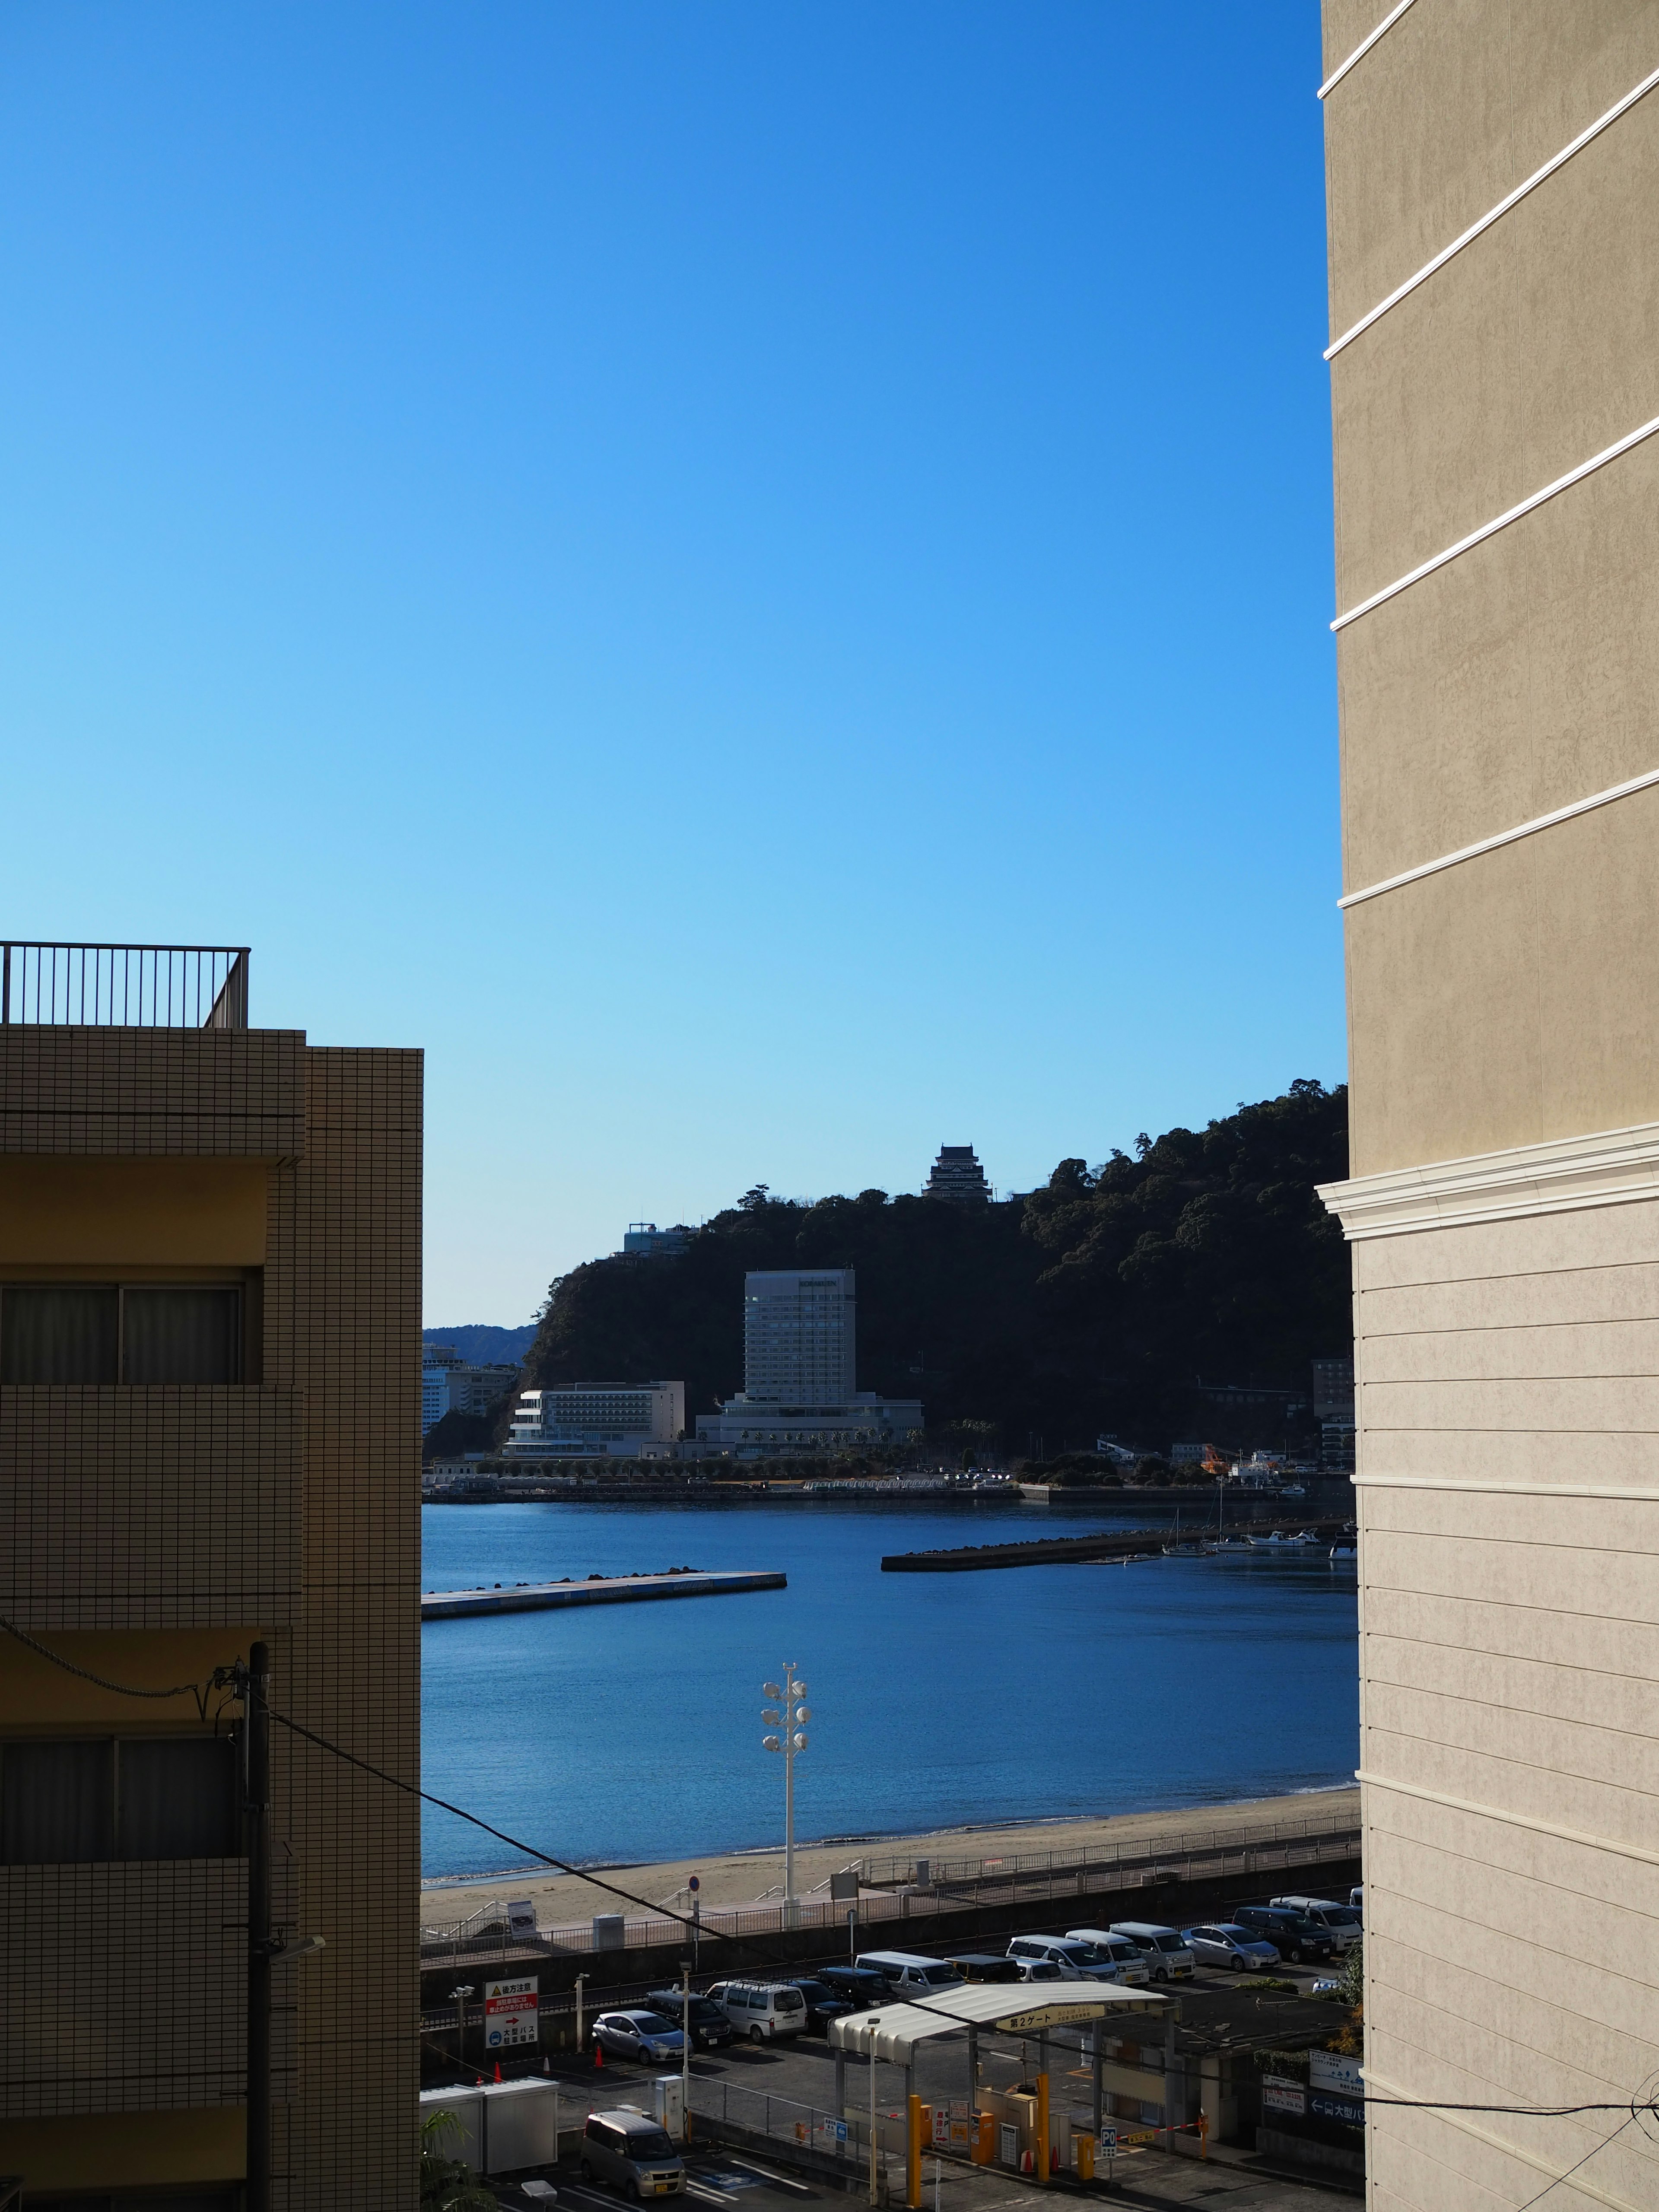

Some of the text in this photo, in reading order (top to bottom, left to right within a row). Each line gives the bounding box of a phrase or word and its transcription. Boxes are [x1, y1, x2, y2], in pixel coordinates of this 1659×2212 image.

[502, 1983, 531, 1994] 後方注意
[496, 1996, 527, 2006] 当駐車場には
[489, 2002, 534, 2013] 車止めがありません
[1011, 2014, 1050, 2028] 第2ゲート
[504, 2026, 534, 2036] 大型バス
[504, 2034, 534, 2044] 駐車場所
[1335, 2105, 1364, 2121] 大型バ
